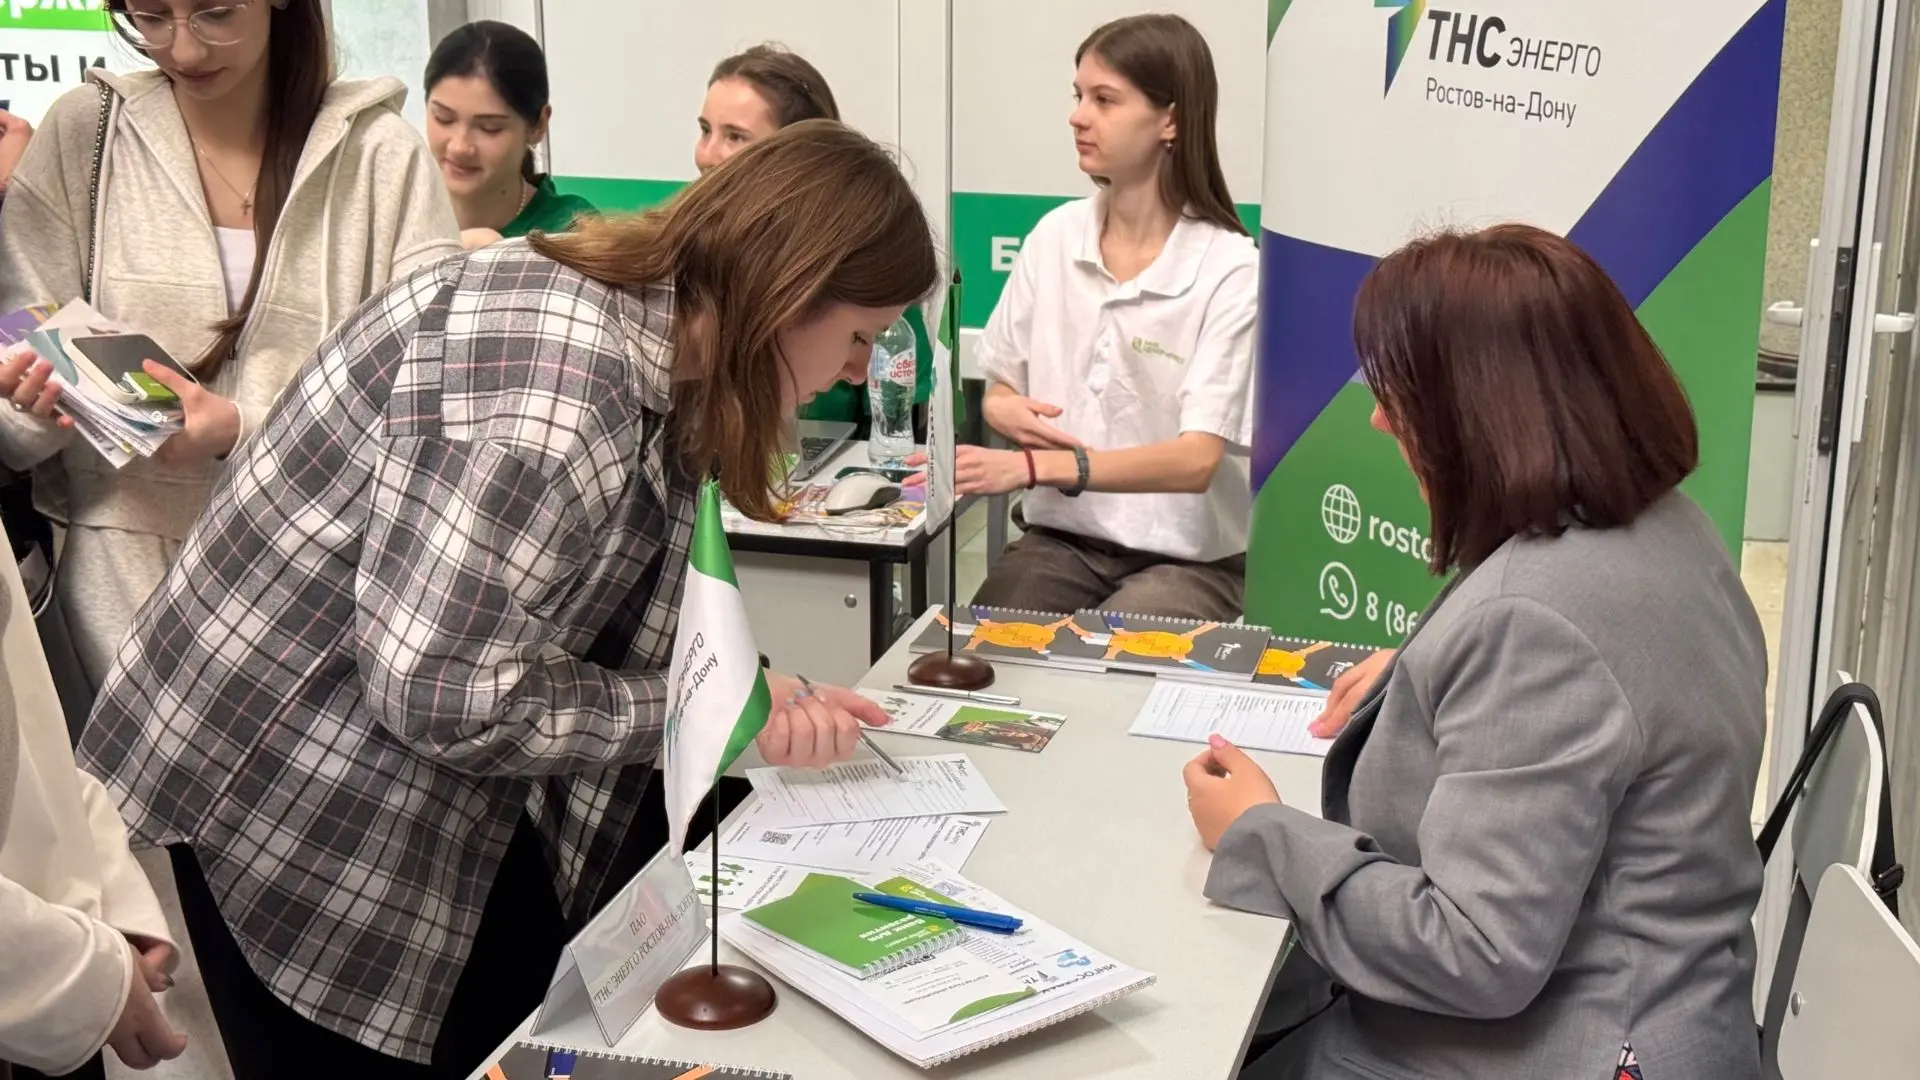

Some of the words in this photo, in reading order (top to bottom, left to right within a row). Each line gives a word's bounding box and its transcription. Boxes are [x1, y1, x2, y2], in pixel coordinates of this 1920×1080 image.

[1428, 10, 1506, 68] ТНС
[1506, 37, 1601, 77] ЭНЕРГО
[1426, 77, 1576, 128] Ростов-на-Дону
[1366, 591, 1379, 622] 8
[629, 911, 647, 936] ПАО
